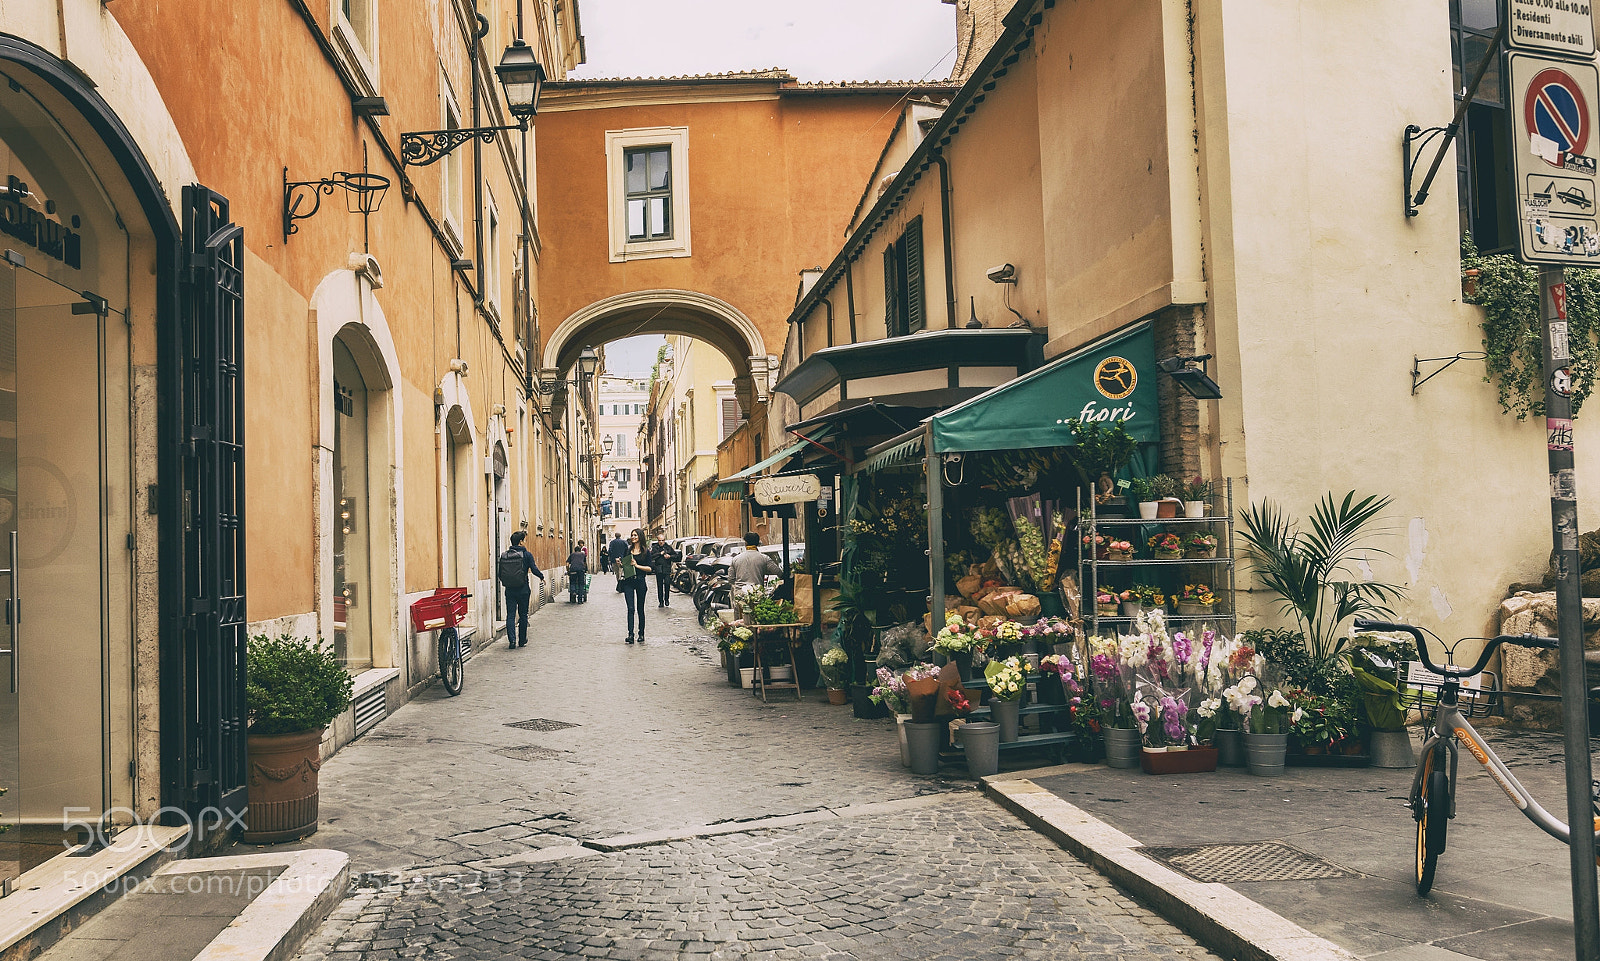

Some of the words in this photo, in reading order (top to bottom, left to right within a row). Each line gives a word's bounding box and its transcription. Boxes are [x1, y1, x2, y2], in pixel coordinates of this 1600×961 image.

[1513, 8, 1551, 24] -Residenti
[1555, 0, 1569, 11] alle
[1570, 2, 1589, 16] 10.00
[1513, 25, 1566, 43] -Diversamente
[1567, 33, 1584, 46] abili
